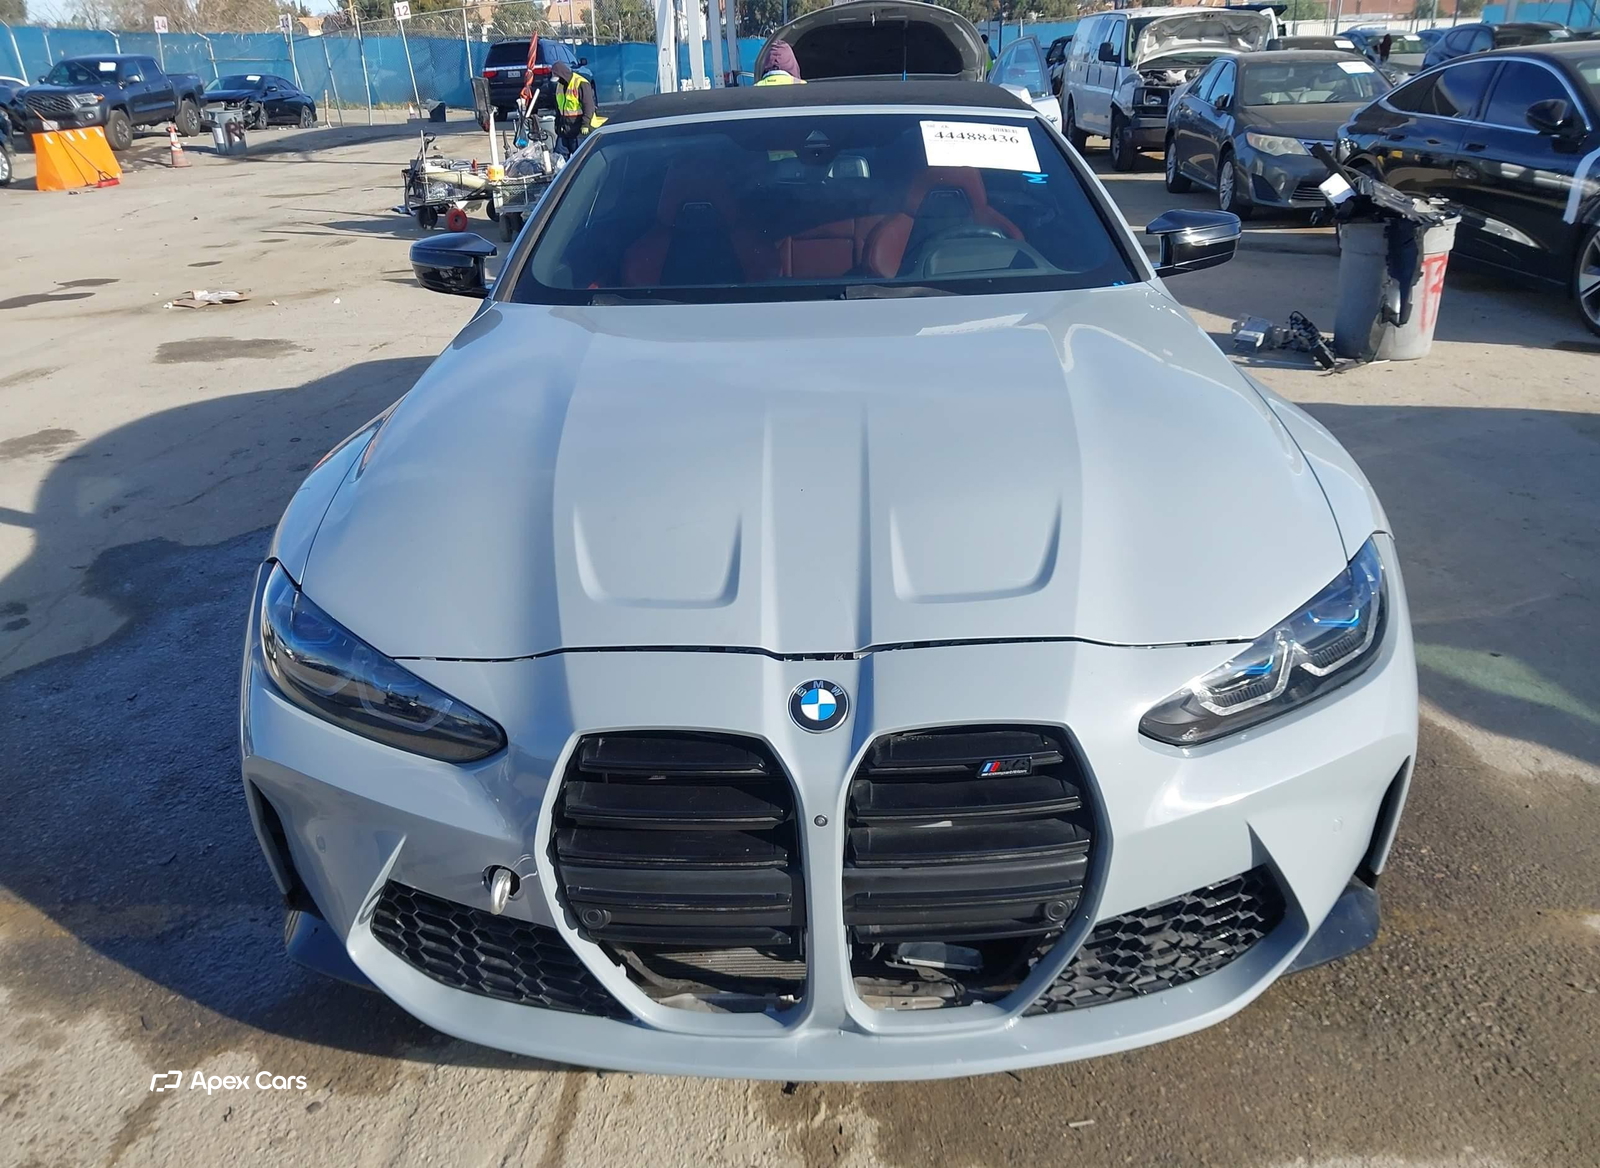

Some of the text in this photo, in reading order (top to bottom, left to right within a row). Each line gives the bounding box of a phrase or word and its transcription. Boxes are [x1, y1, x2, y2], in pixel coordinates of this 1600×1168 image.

[396, 5, 409, 17] 12
[155, 19, 167, 30] 14
[934, 130, 1019, 145] 44488436
[796, 680, 842, 698] BMW
